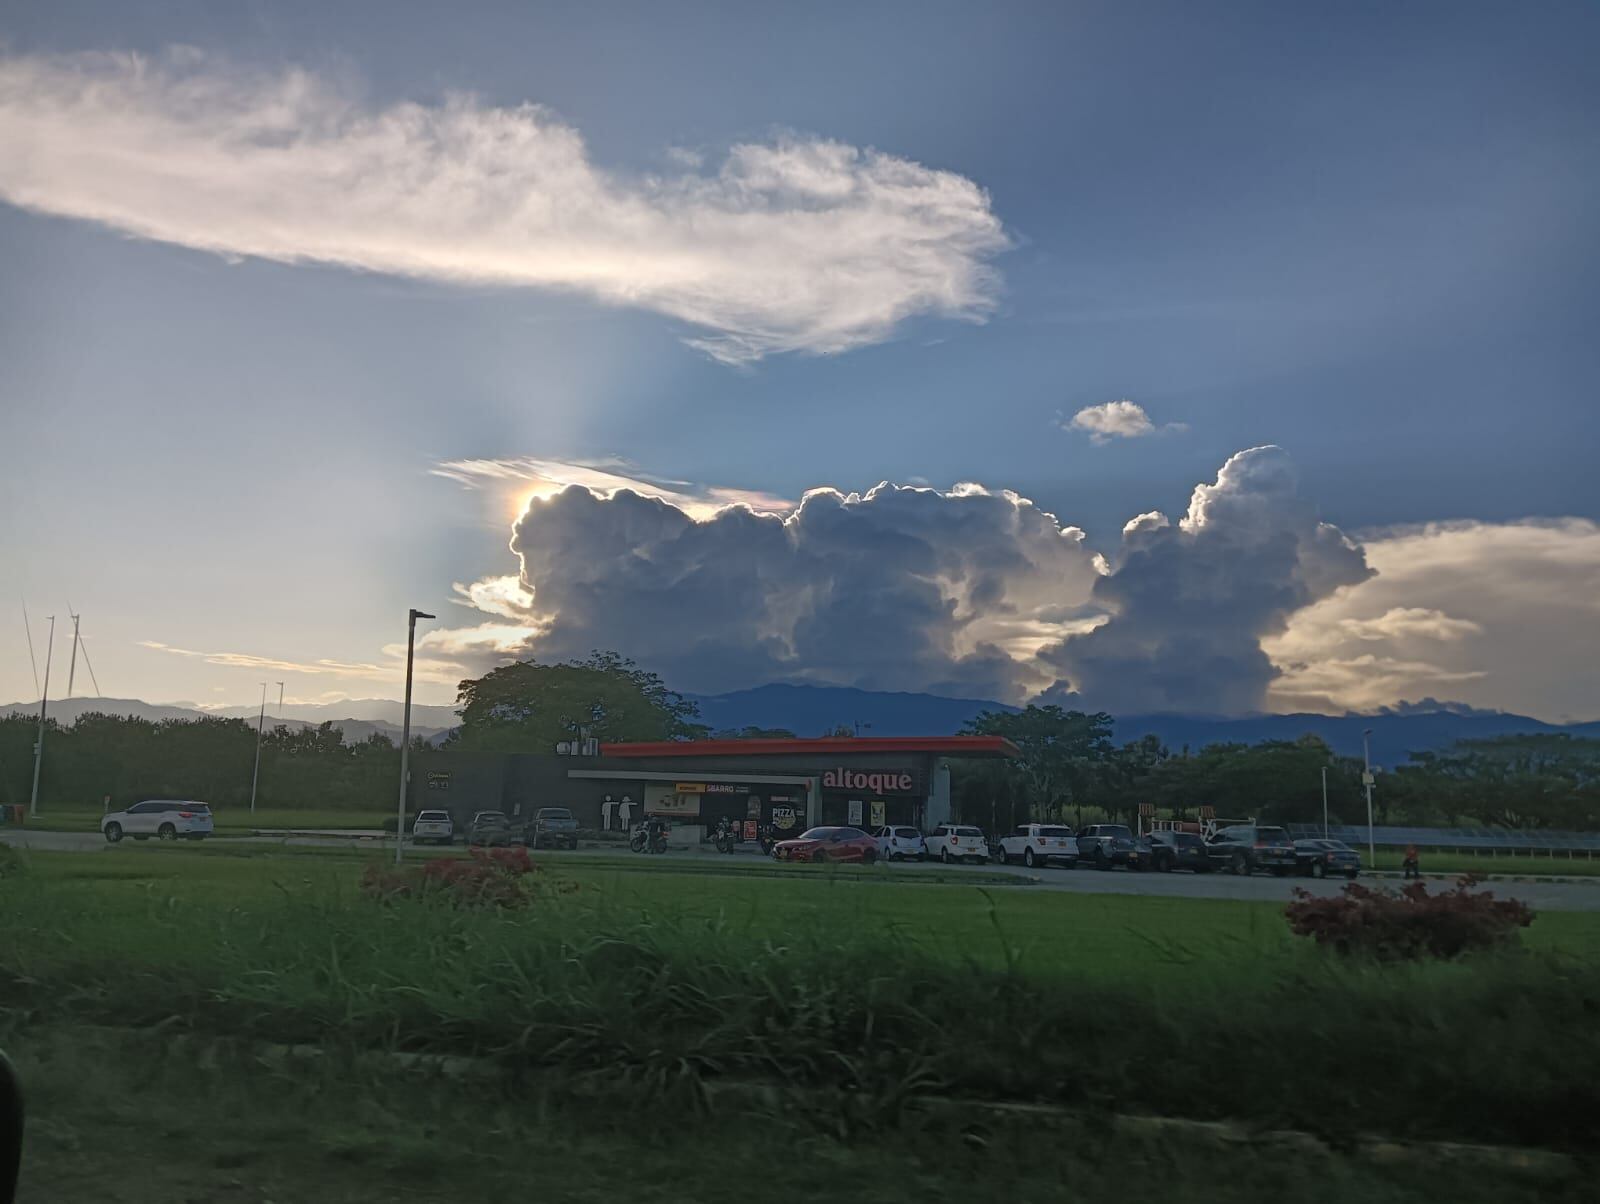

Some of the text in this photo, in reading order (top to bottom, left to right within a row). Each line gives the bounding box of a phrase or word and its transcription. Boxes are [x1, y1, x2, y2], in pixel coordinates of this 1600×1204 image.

[824, 767, 912, 795] altoque
[706, 784, 734, 793] SBARRO
[772, 808, 795, 818] PIZZA
